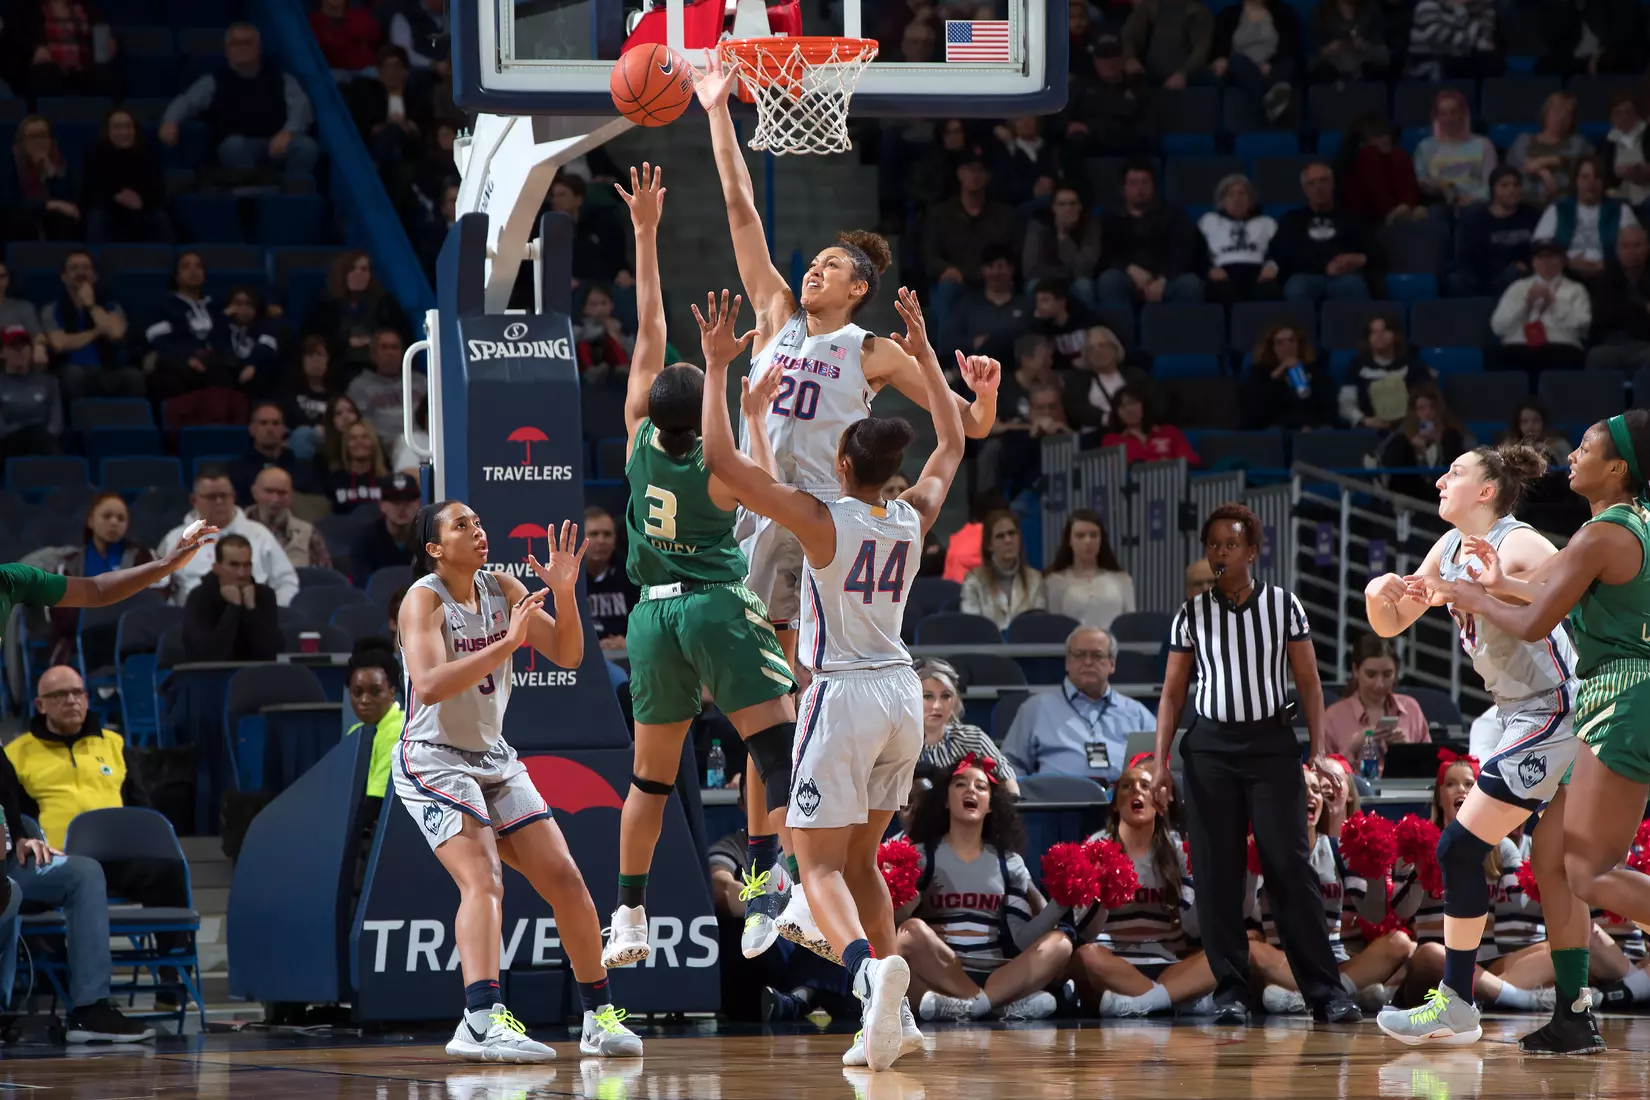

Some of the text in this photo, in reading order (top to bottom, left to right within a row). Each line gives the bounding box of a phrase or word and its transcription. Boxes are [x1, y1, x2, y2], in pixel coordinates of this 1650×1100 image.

[467, 338, 571, 361] SPALDING
[771, 352, 840, 379] HUSKIES
[772, 376, 821, 420] 20
[483, 466, 572, 481] TRAVELERS
[643, 484, 677, 540] 3
[844, 540, 911, 604] 44
[511, 671, 577, 686] AVELERS
[363, 915, 719, 972] TRVERS
